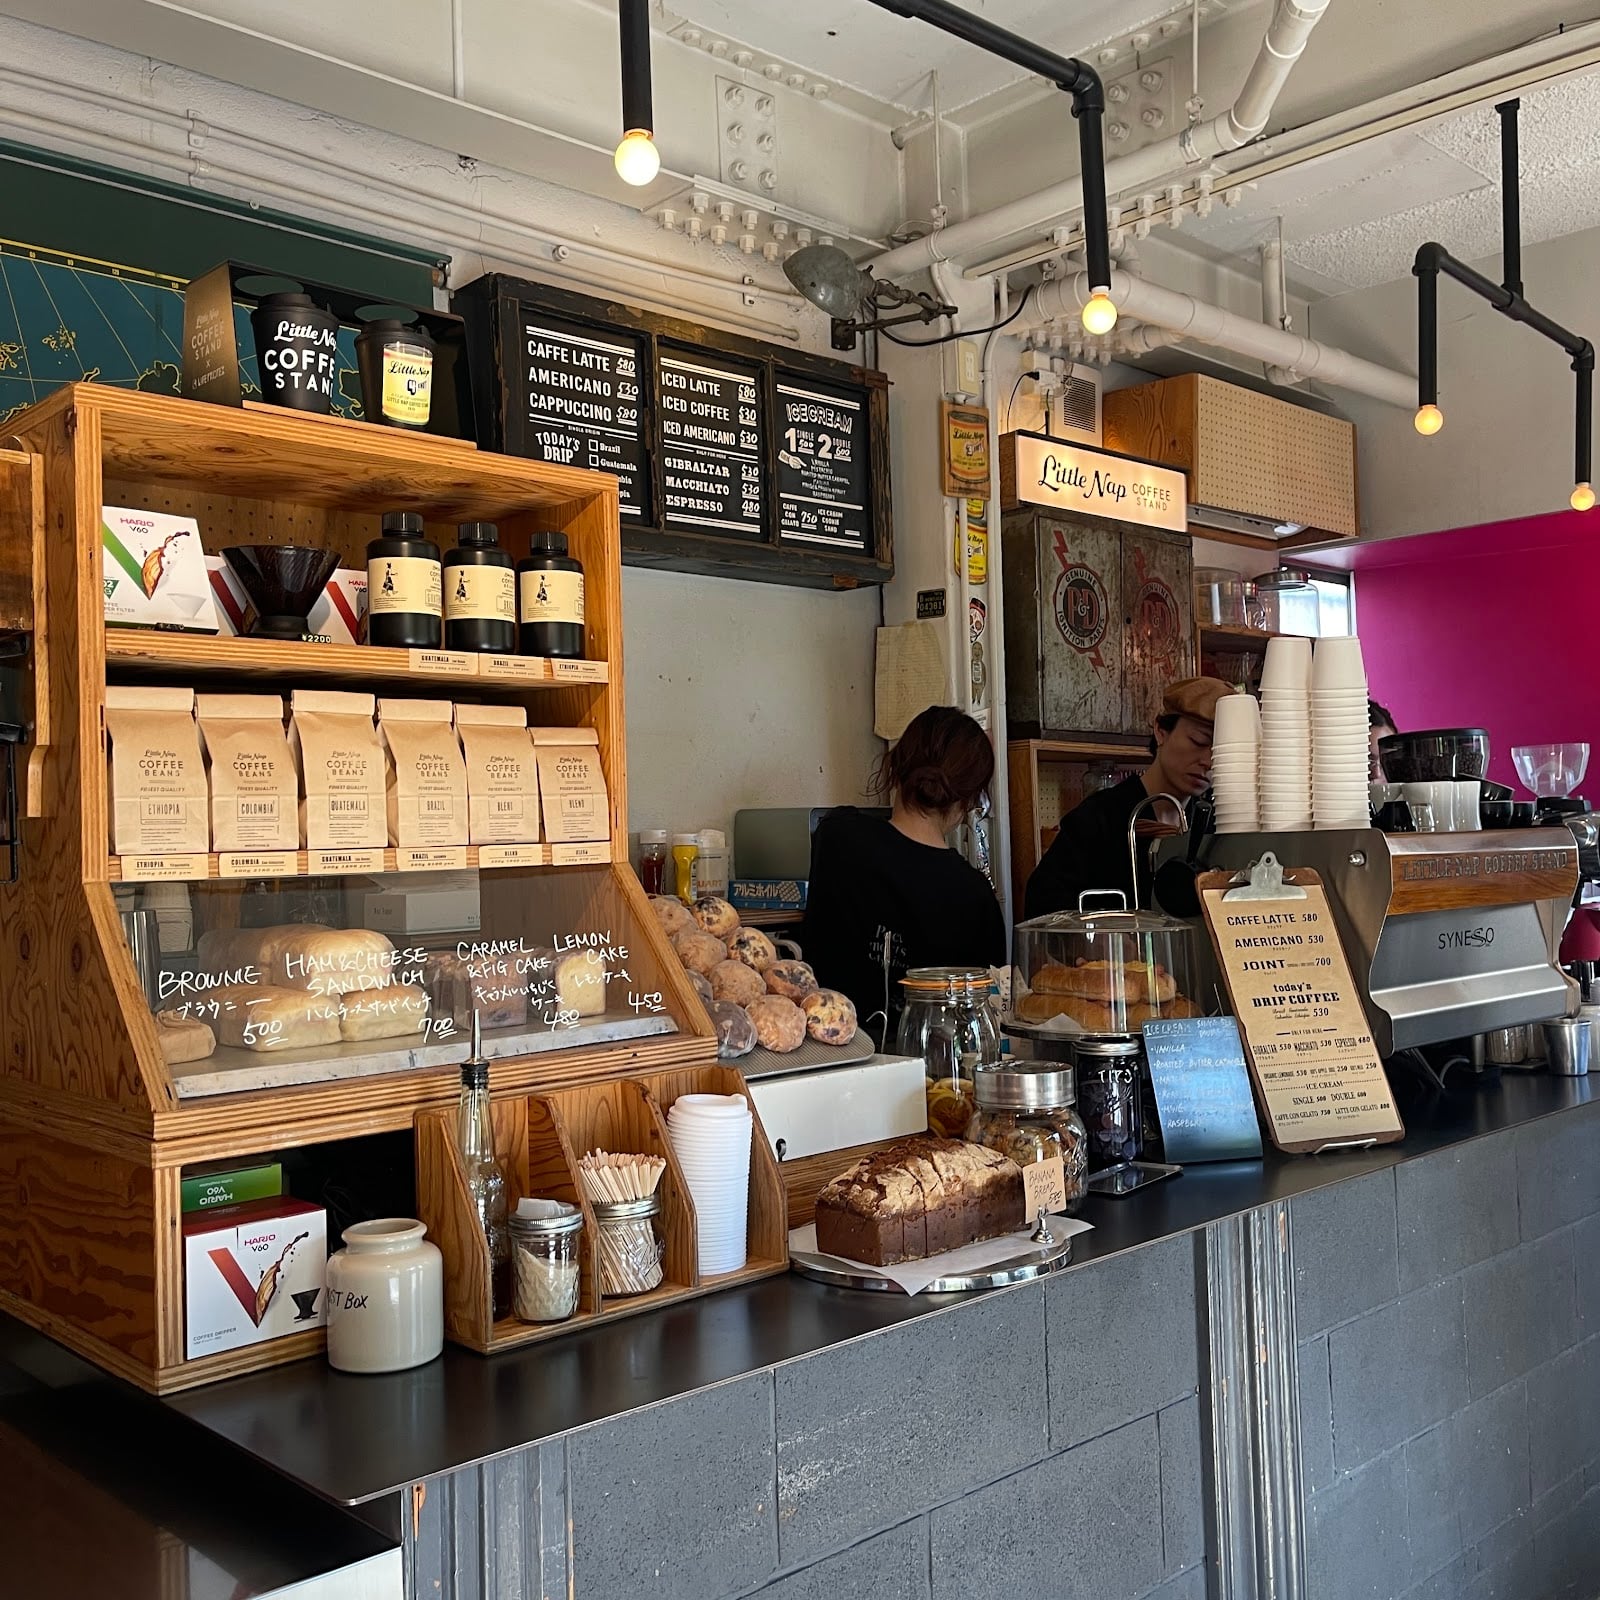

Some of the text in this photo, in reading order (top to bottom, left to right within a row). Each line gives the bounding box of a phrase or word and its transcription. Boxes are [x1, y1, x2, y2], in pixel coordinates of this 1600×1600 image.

[191, 321, 225, 350] COFFEE
[273, 320, 319, 342] Little
[195, 339, 222, 361] STAND
[527, 340, 636, 373] CAFFE LATTE 580
[387, 360, 417, 376] Little
[274, 372, 334, 399] STAN
[528, 366, 612, 398] AMERICANO
[661, 371, 687, 390] ICED
[689, 379, 721, 397] LATTE
[529, 391, 612, 423] CAPPUCCINO
[662, 395, 688, 413] ICED
[690, 401, 730, 422] COFFEE
[535, 431, 581, 452] TODAY'S
[663, 420, 682, 436] ICED
[683, 424, 736, 446] AMERICANO
[785, 427, 797, 453] 1
[953, 426, 985, 441] Little Nap
[599, 442, 621, 455] Brazil
[798, 439, 814, 449] 500
[818, 433, 833, 460] 2
[543, 444, 574, 464] DRIP
[600, 458, 638, 472] Guatemala
[664, 457, 730, 478] GIBRALTAR
[665, 476, 730, 496] MACCHIATO
[1037, 454, 1171, 502] Little Nap COFFEE
[665, 494, 760, 513] ESPRESSO 480
[1136, 498, 1168, 511] STAND
[119, 517, 155, 531] HARIO
[129, 525, 149, 534] V60
[1065, 567, 1097, 587] GENUINE
[1067, 586, 1099, 630] P&D
[1057, 610, 1105, 646] IGNITION PARTS
[301, 633, 331, 645] ¥2200
[143, 749, 162, 758] Little
[236, 752, 252, 760] Little
[138, 759, 184, 770] COFFEE
[232, 761, 275, 771] COFFEE
[326, 759, 367, 769] COFFEE
[415, 762, 451, 771] COFFEE
[331, 769, 365, 777] BEANS
[148, 803, 180, 815] ETHIOPIA
[240, 803, 274, 814] COLOMBIA
[329, 800, 367, 812] GUATEMALA
[426, 800, 445, 811] BRAZIL
[231, 858, 259, 866] COLOMBIA
[1403, 851, 1569, 882] LITTLE NAP COFFEE STAND
[733, 883, 780, 898] アルミホイル
[1226, 913, 1318, 926] CAFFE LATTE 580
[552, 929, 612, 954] LEMON
[1234, 934, 1324, 949] AMERICANO 530
[1438, 926, 1495, 951] SYNESSO
[456, 937, 534, 962] CARAMEL
[585, 946, 630, 966] CAKE
[515, 956, 553, 976] CAKE
[1242, 959, 1286, 971] JOINT
[1315, 957, 1331, 967] 700
[158, 964, 263, 1001] BROWNIE
[305, 969, 425, 1000] SANDWICH
[573, 968, 633, 988] レモンケーキ
[1273, 981, 1312, 993] today's
[530, 994, 565, 1012] ケーキ
[628, 990, 663, 1014] 450
[1252, 992, 1340, 1008] DRIP COFFEE
[176, 997, 272, 1022] ブラウニー
[1312, 1007, 1329, 1017] 530
[417, 1016, 455, 1043] 700
[543, 1009, 580, 1033] 480
[242, 1019, 285, 1046] 500
[1144, 1024, 1160, 1036] ICE
[1252, 1043, 1278, 1055] GIBRALTAR
[1279, 1043, 1292, 1051] 530
[1336, 1065, 1348, 1073] 250
[1365, 1062, 1377, 1070] 250
[1305, 1080, 1344, 1090] ICE CREAM
[1292, 1092, 1355, 1105] SINGLE DOUBLE
[1334, 1107, 1349, 1116] LATTE
[1029, 1167, 1056, 1187] BANANA
[206, 1185, 226, 1195] V60
[1034, 1181, 1055, 1200] BREAD
[199, 1192, 233, 1206] HARIO
[244, 1233, 276, 1246] HARIO
[251, 1242, 269, 1253] V60
